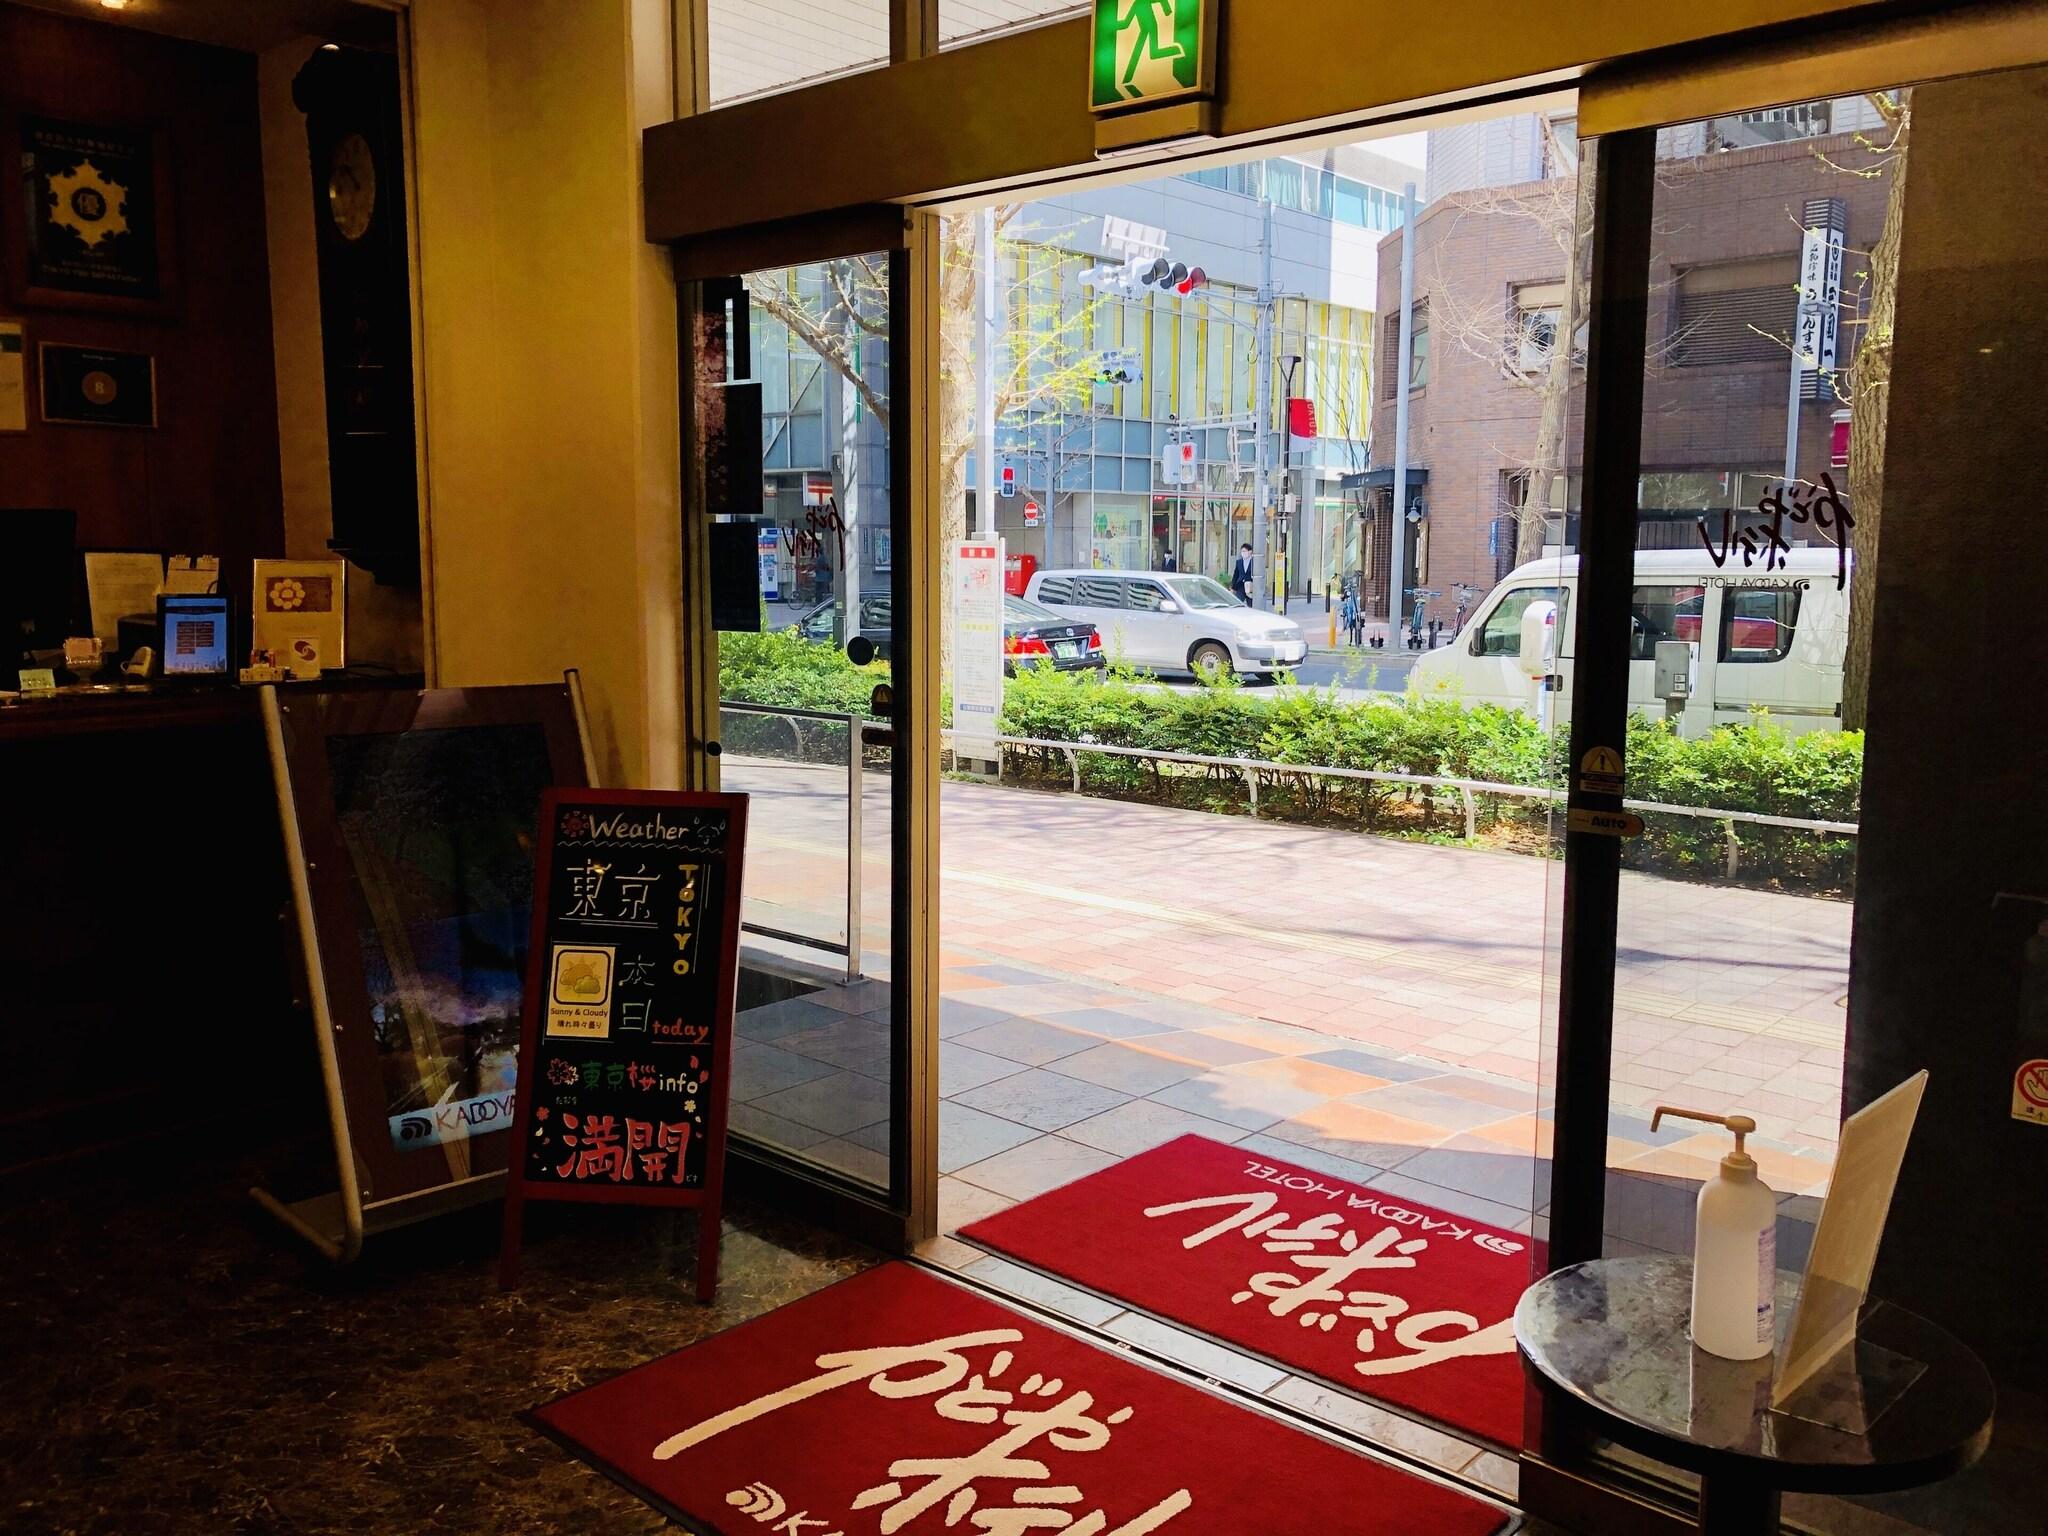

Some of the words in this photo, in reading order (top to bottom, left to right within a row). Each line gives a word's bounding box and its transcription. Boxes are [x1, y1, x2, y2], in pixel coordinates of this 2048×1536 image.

[588, 811, 689, 840] Weather
[565, 857, 662, 919] 東京
[672, 864, 700, 975] TOKYO
[550, 1007, 573, 1017] Sunny
[574, 1008, 581, 1016] &
[583, 1008, 609, 1018] Cloudy
[652, 1017, 710, 1044] today
[556, 1111, 691, 1185] 満開
[1244, 1159, 1347, 1202] HOTEL
[1347, 1191, 1470, 1242] KADOYA
